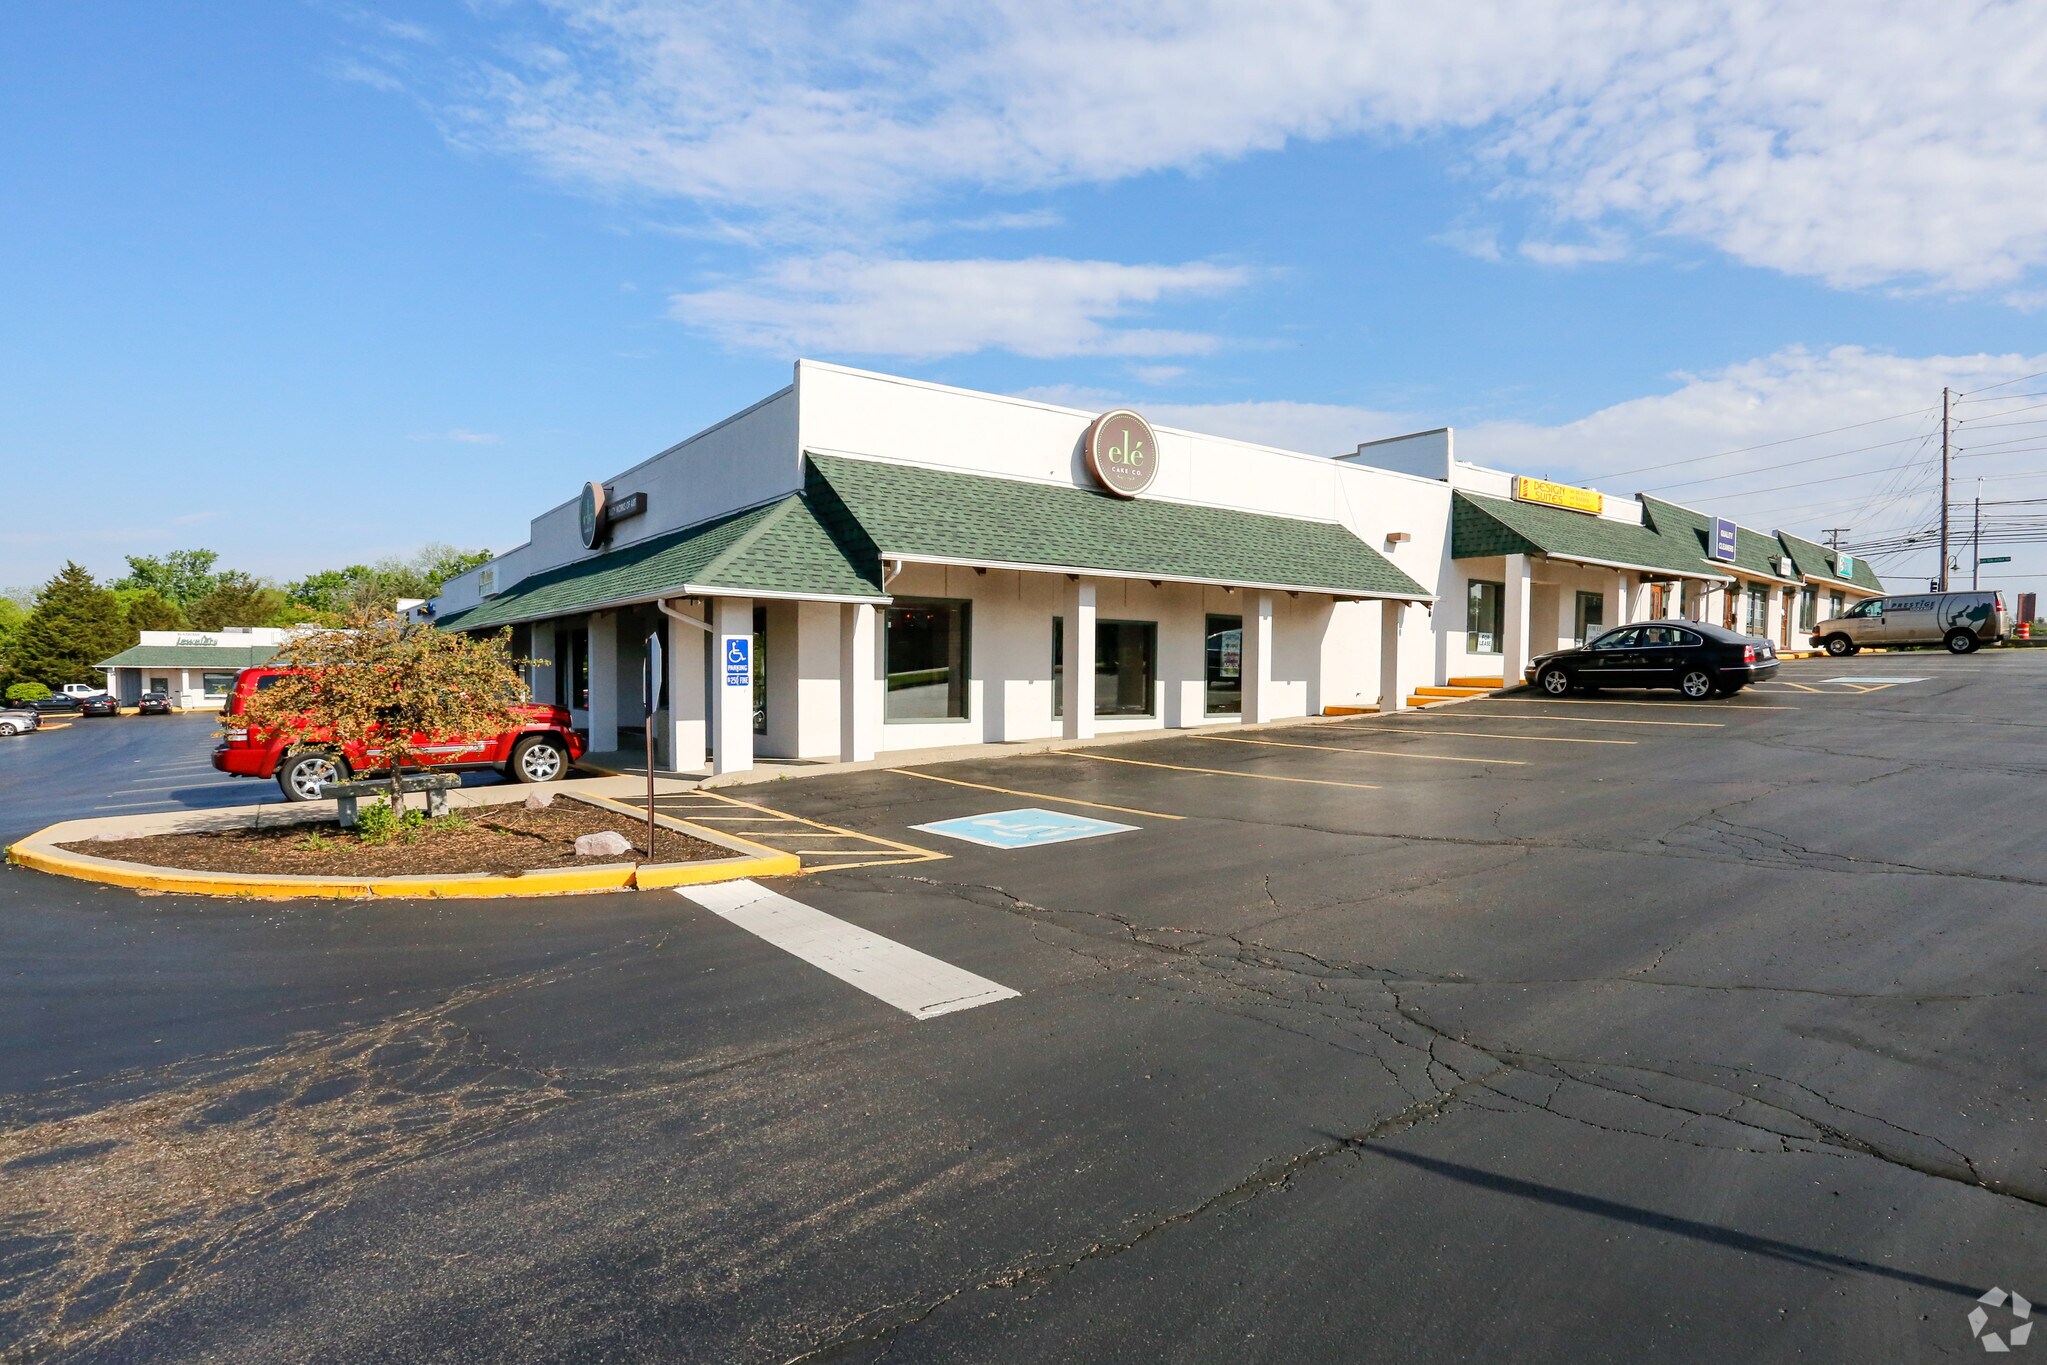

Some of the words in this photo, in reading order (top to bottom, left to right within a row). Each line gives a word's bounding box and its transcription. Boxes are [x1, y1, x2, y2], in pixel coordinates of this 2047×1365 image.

[1108, 429, 1144, 467] elé
[1111, 466, 1129, 475] CAKE
[1131, 469, 1143, 477] CO.
[1534, 481, 1566, 496] DESIGN
[1535, 491, 1564, 505] SUITES
[1720, 529, 1734, 540] QUALITY
[1718, 542, 1734, 553] CLEANERS
[1891, 599, 1936, 609] PRESTIGE
